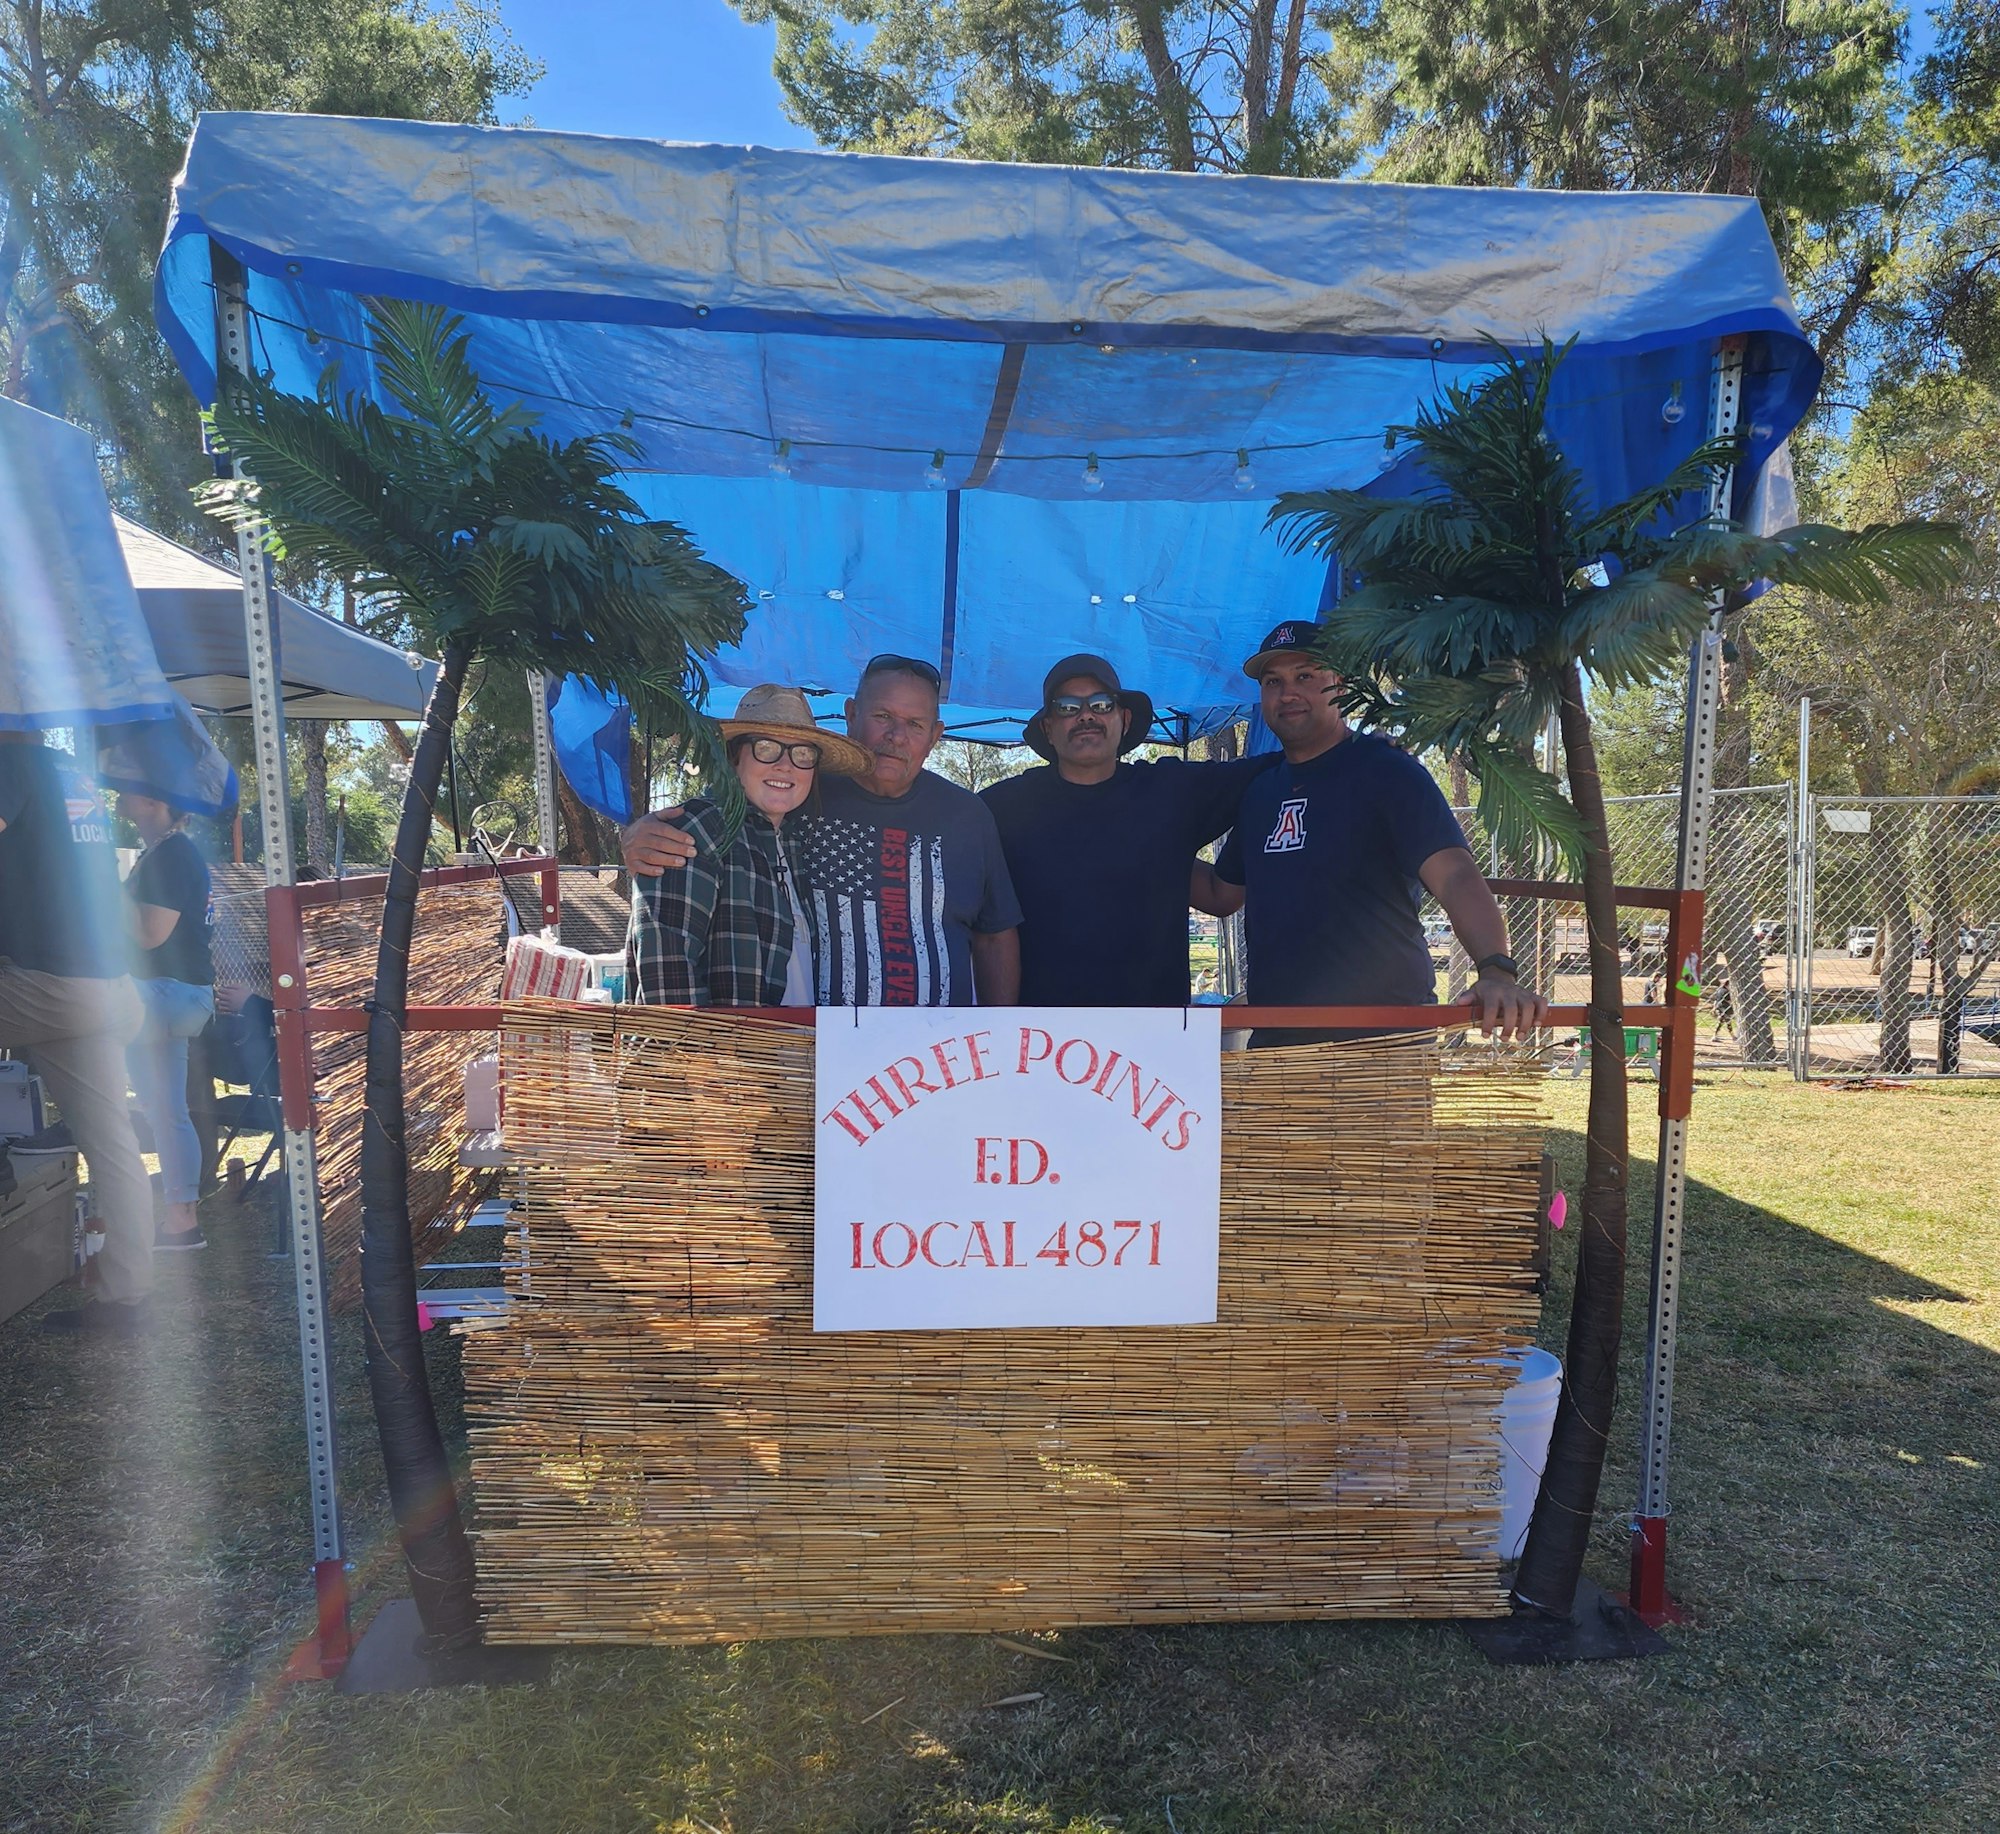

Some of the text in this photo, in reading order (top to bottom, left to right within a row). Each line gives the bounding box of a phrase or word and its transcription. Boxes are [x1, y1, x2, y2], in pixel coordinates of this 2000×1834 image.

[1264, 798, 1308, 853] A
[880, 827, 915, 1005] BEST UNCLE EVE
[821, 1027, 1202, 1151] THREE POINTS
[973, 1137, 1061, 1185] F.D.
[850, 1220, 1161, 1269] LOCAL 4871
